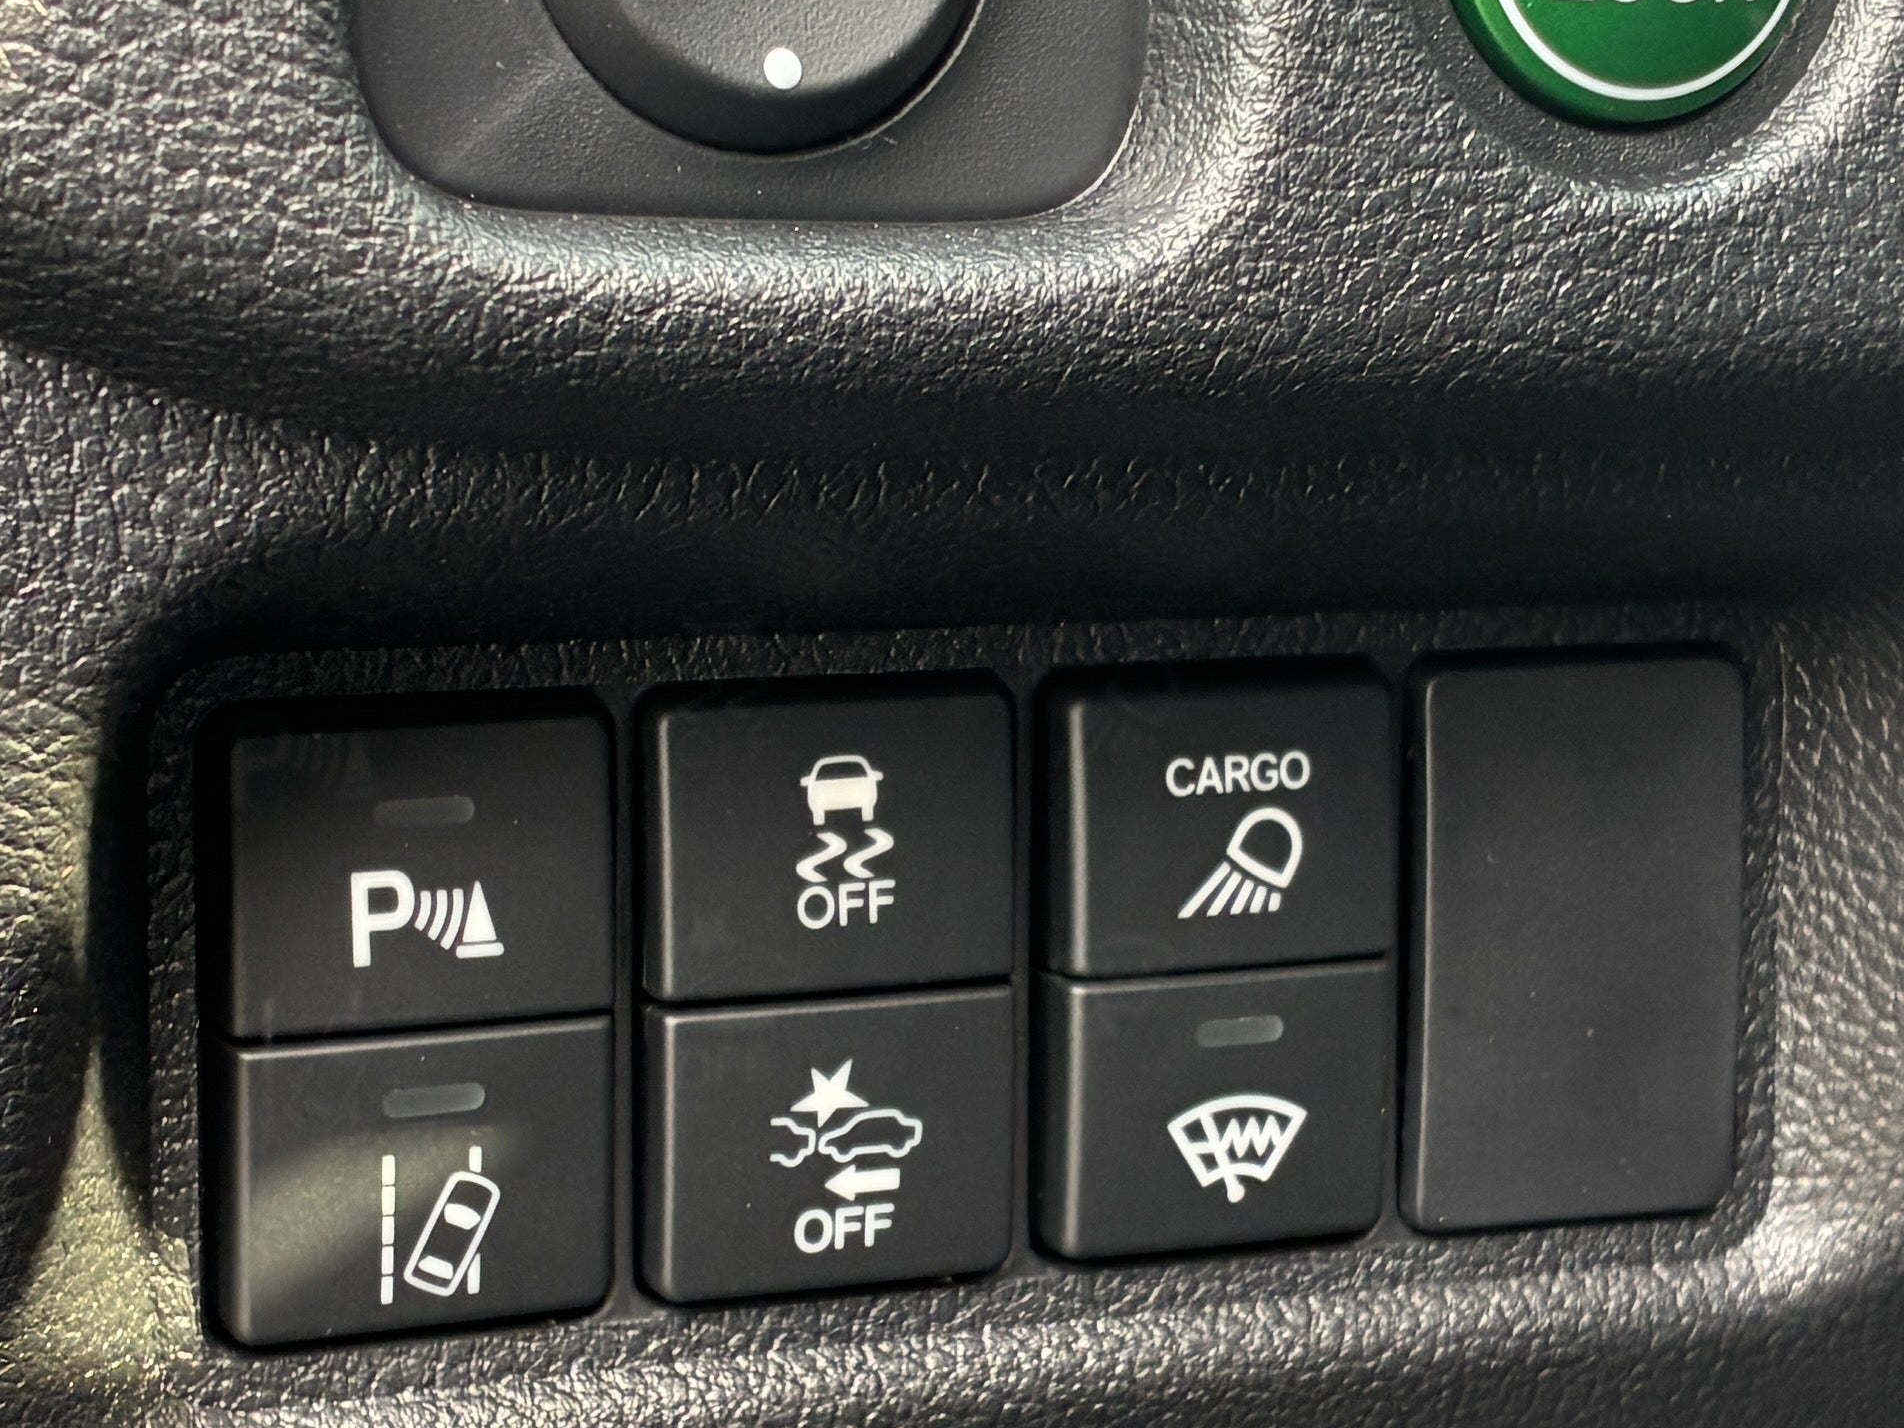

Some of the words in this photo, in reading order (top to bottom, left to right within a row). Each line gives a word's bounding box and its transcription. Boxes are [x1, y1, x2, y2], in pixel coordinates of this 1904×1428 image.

[1165, 750, 1311, 798] CARGO
[350, 870, 416, 968] P
[796, 879, 896, 930] OFF
[793, 1202, 895, 1254] OFF
